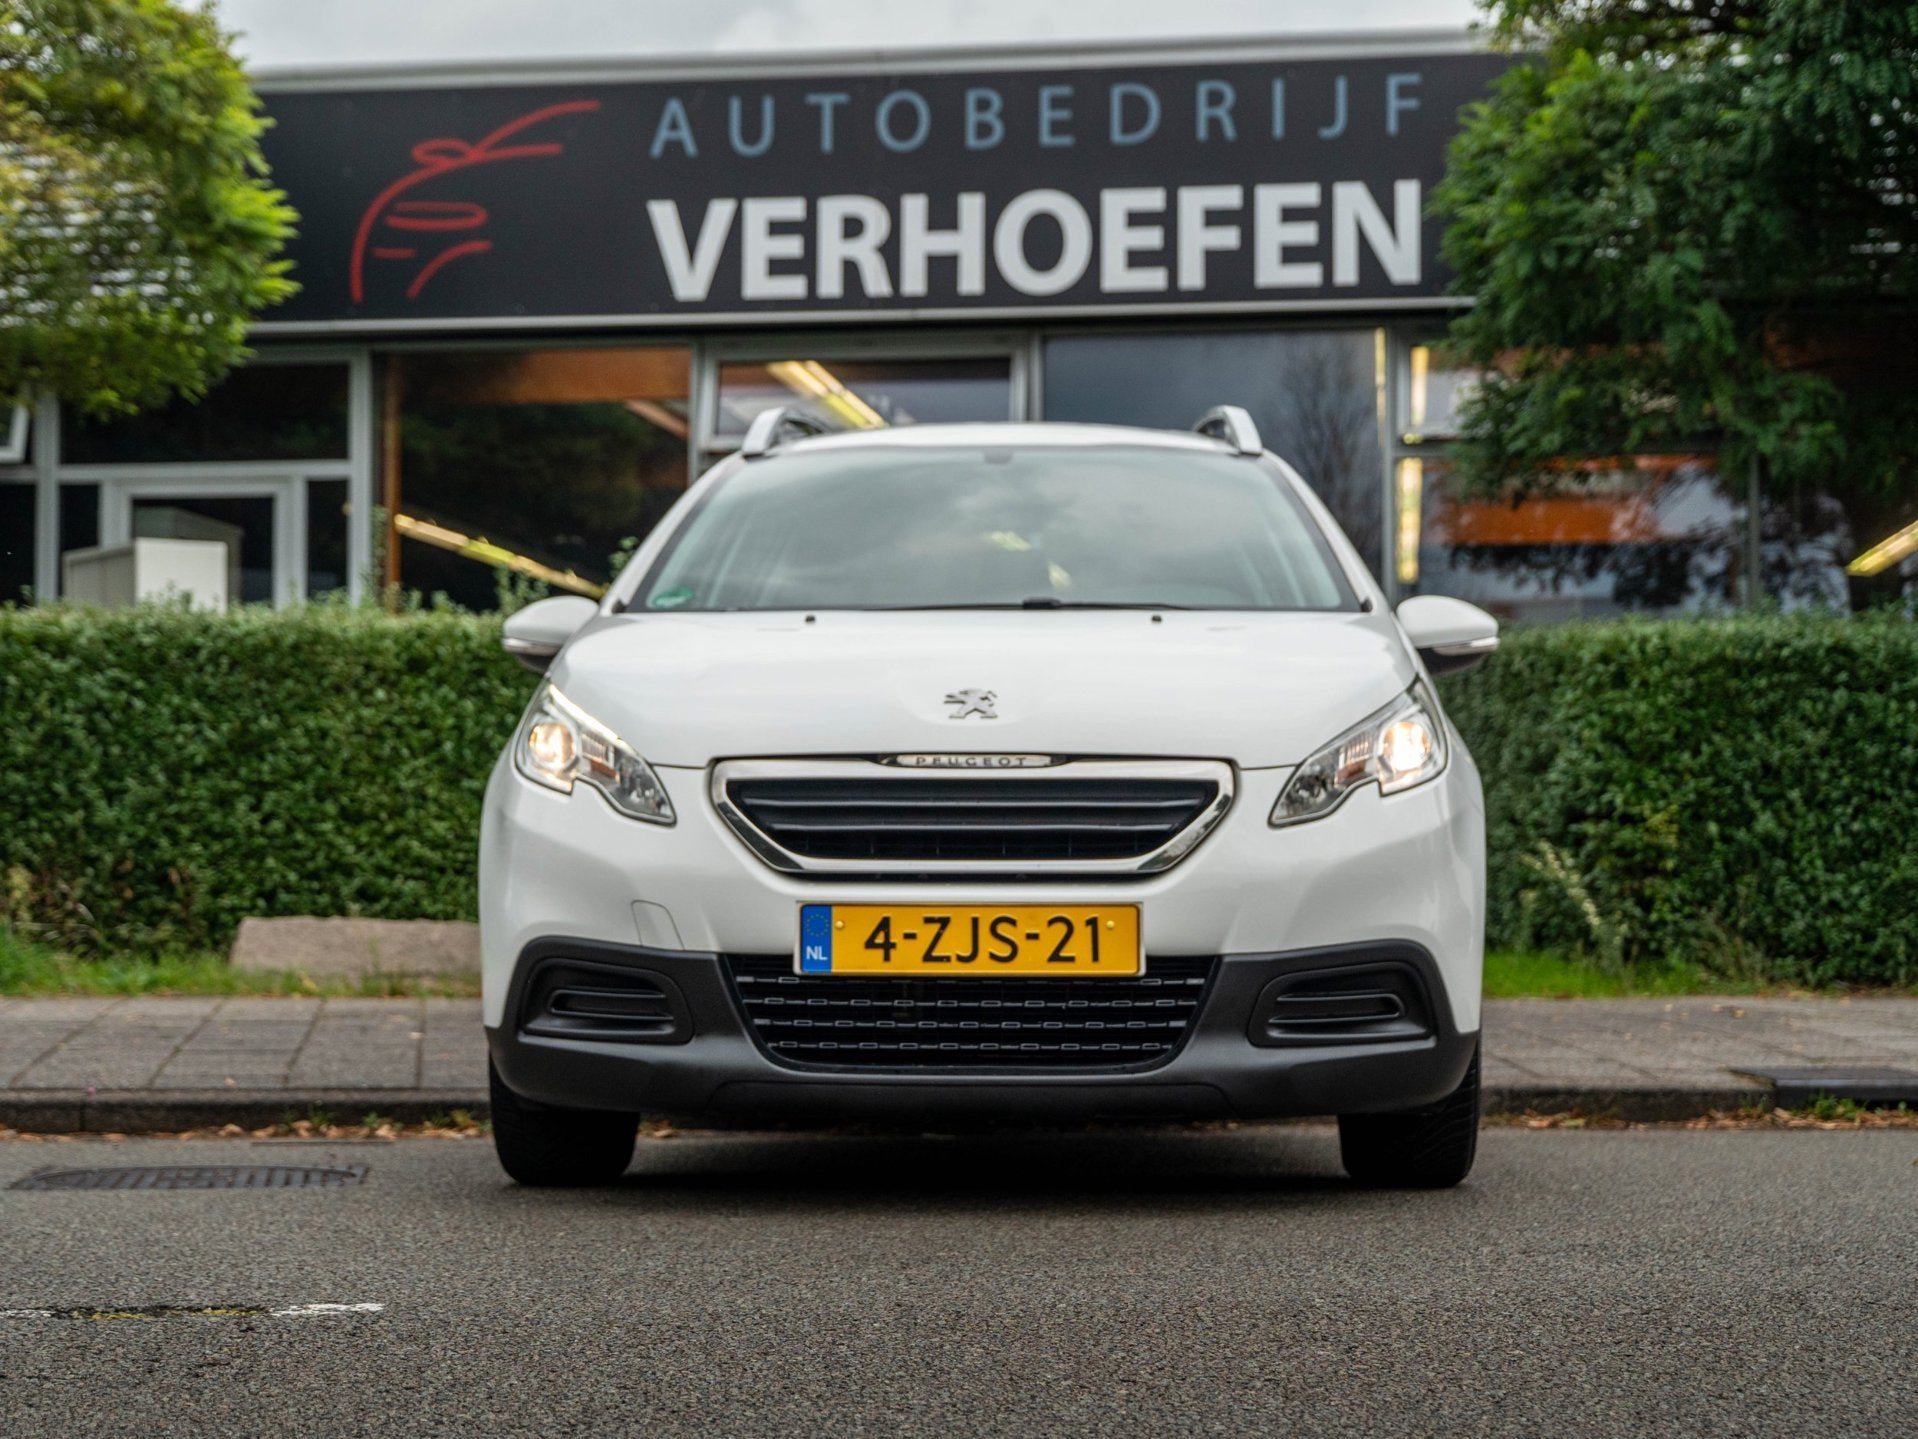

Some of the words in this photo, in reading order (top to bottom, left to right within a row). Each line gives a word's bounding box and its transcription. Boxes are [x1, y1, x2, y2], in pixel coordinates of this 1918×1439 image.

[650, 73, 1423, 158] AUTOBEDRIJF
[647, 179, 1423, 302] VERHOEFEN
[916, 756, 1027, 767] PEUGEOT
[806, 946, 828, 961] NL
[864, 915, 1100, 964] 4-ZJS-21
